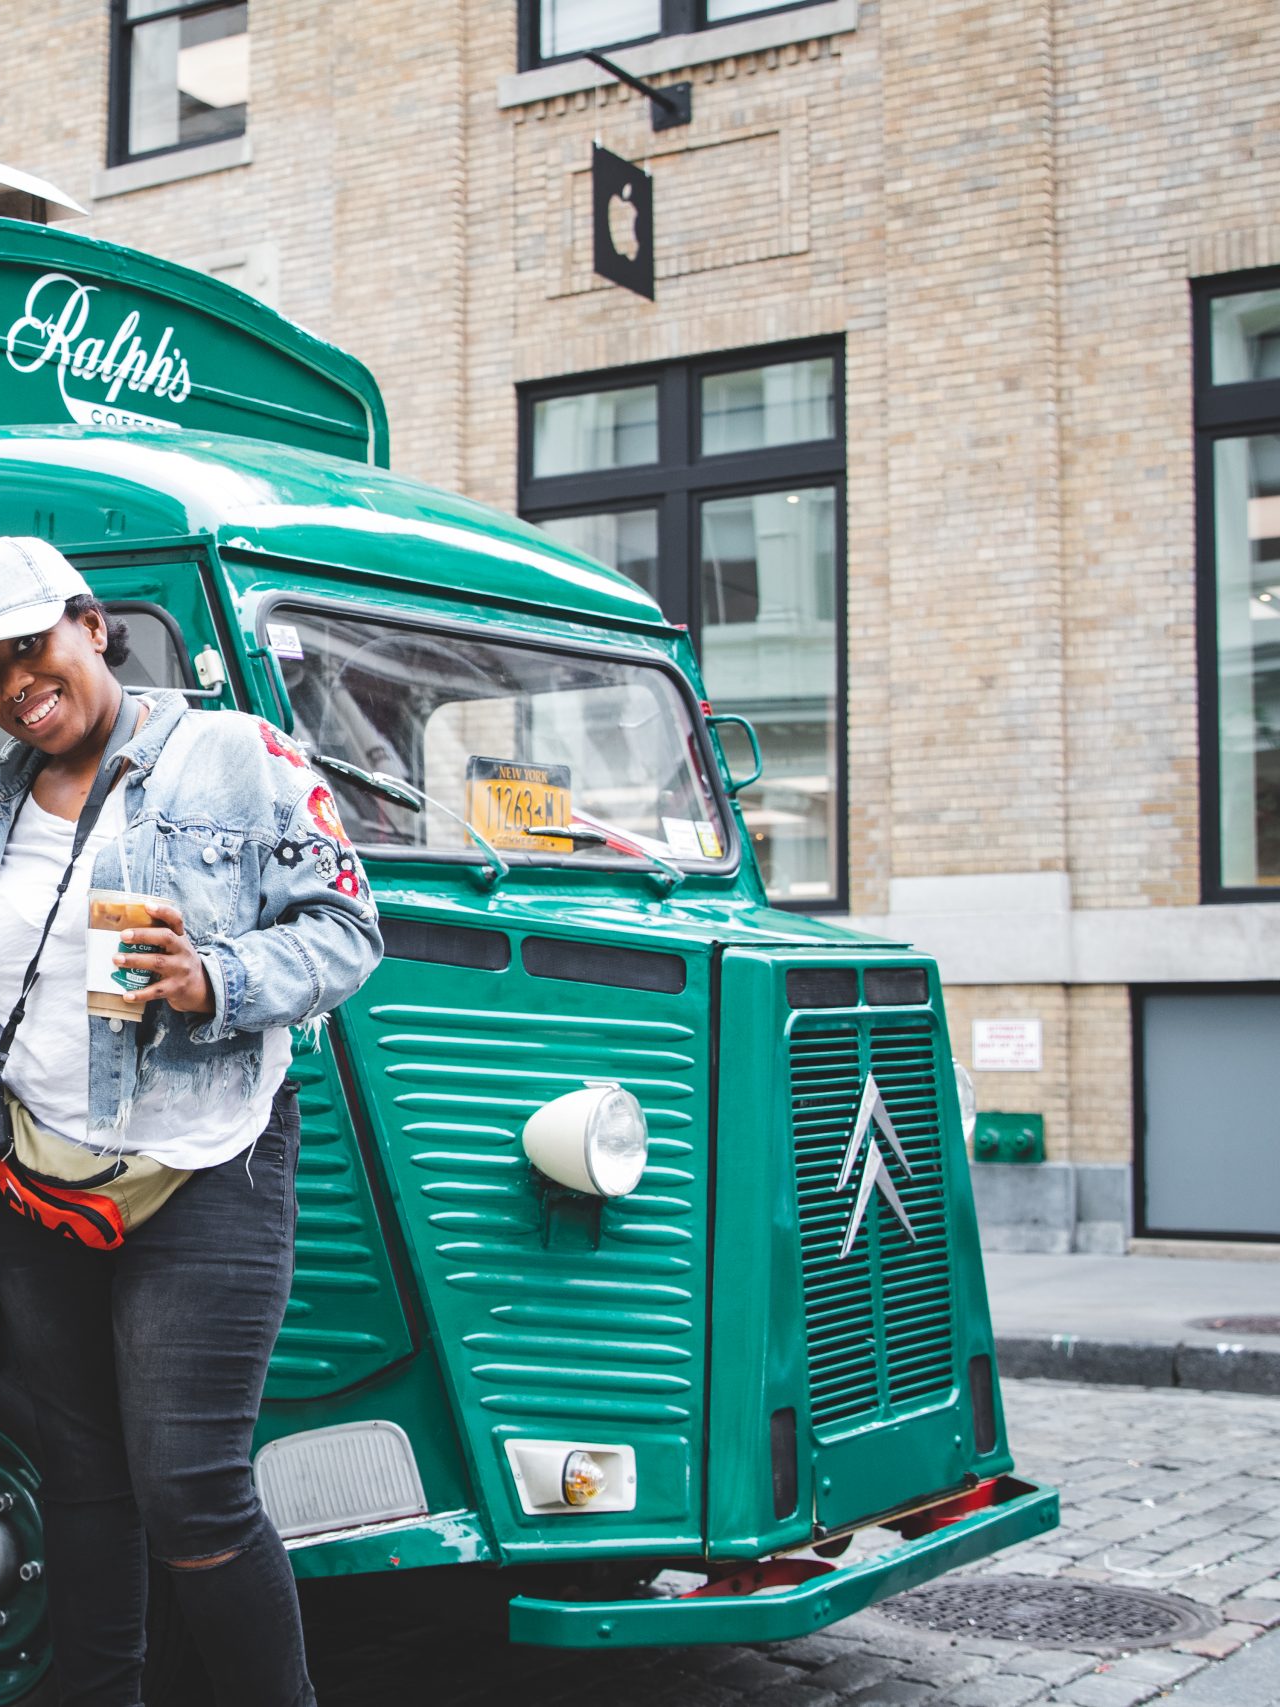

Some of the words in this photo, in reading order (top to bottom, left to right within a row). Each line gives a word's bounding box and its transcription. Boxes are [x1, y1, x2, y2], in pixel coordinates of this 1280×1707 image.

[6, 273, 192, 403] Ralph's
[499, 765, 521, 780] NEW
[523, 769, 549, 783] YORK
